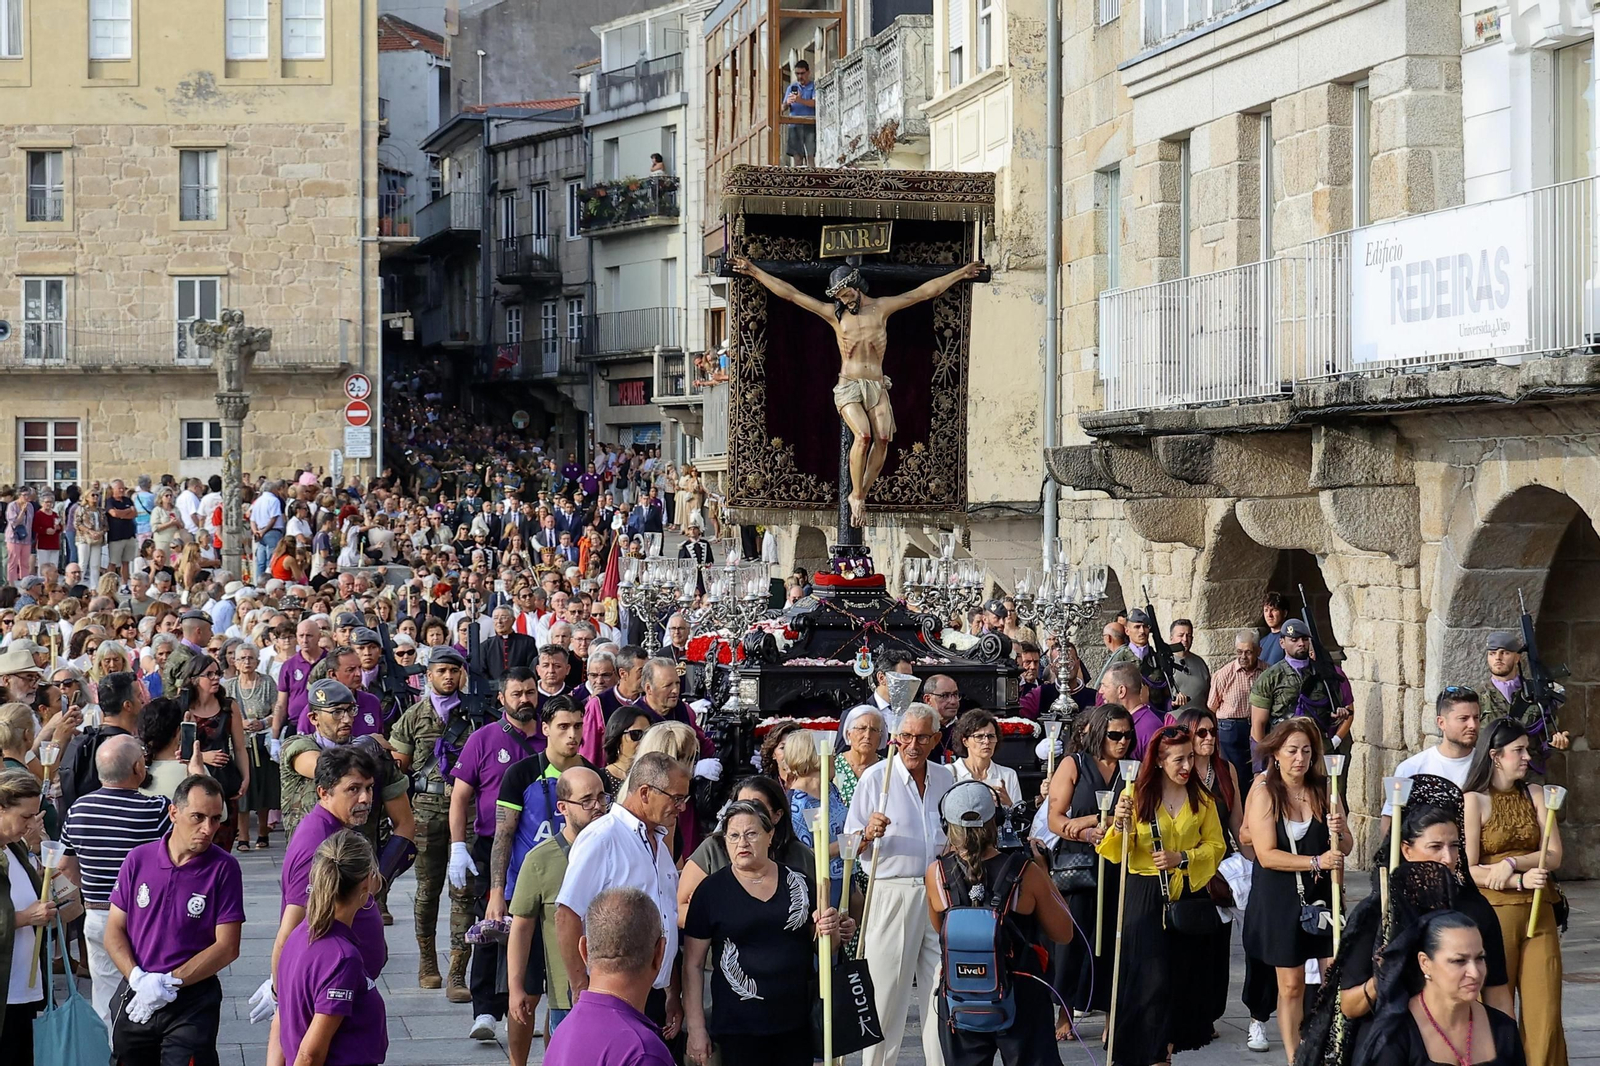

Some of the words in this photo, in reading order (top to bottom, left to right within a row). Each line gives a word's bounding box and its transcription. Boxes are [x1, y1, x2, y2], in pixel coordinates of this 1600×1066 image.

[1365, 237, 1403, 273] Edificio
[1390, 245, 1511, 326] REDEIRAS
[957, 965, 986, 975] LiveU
